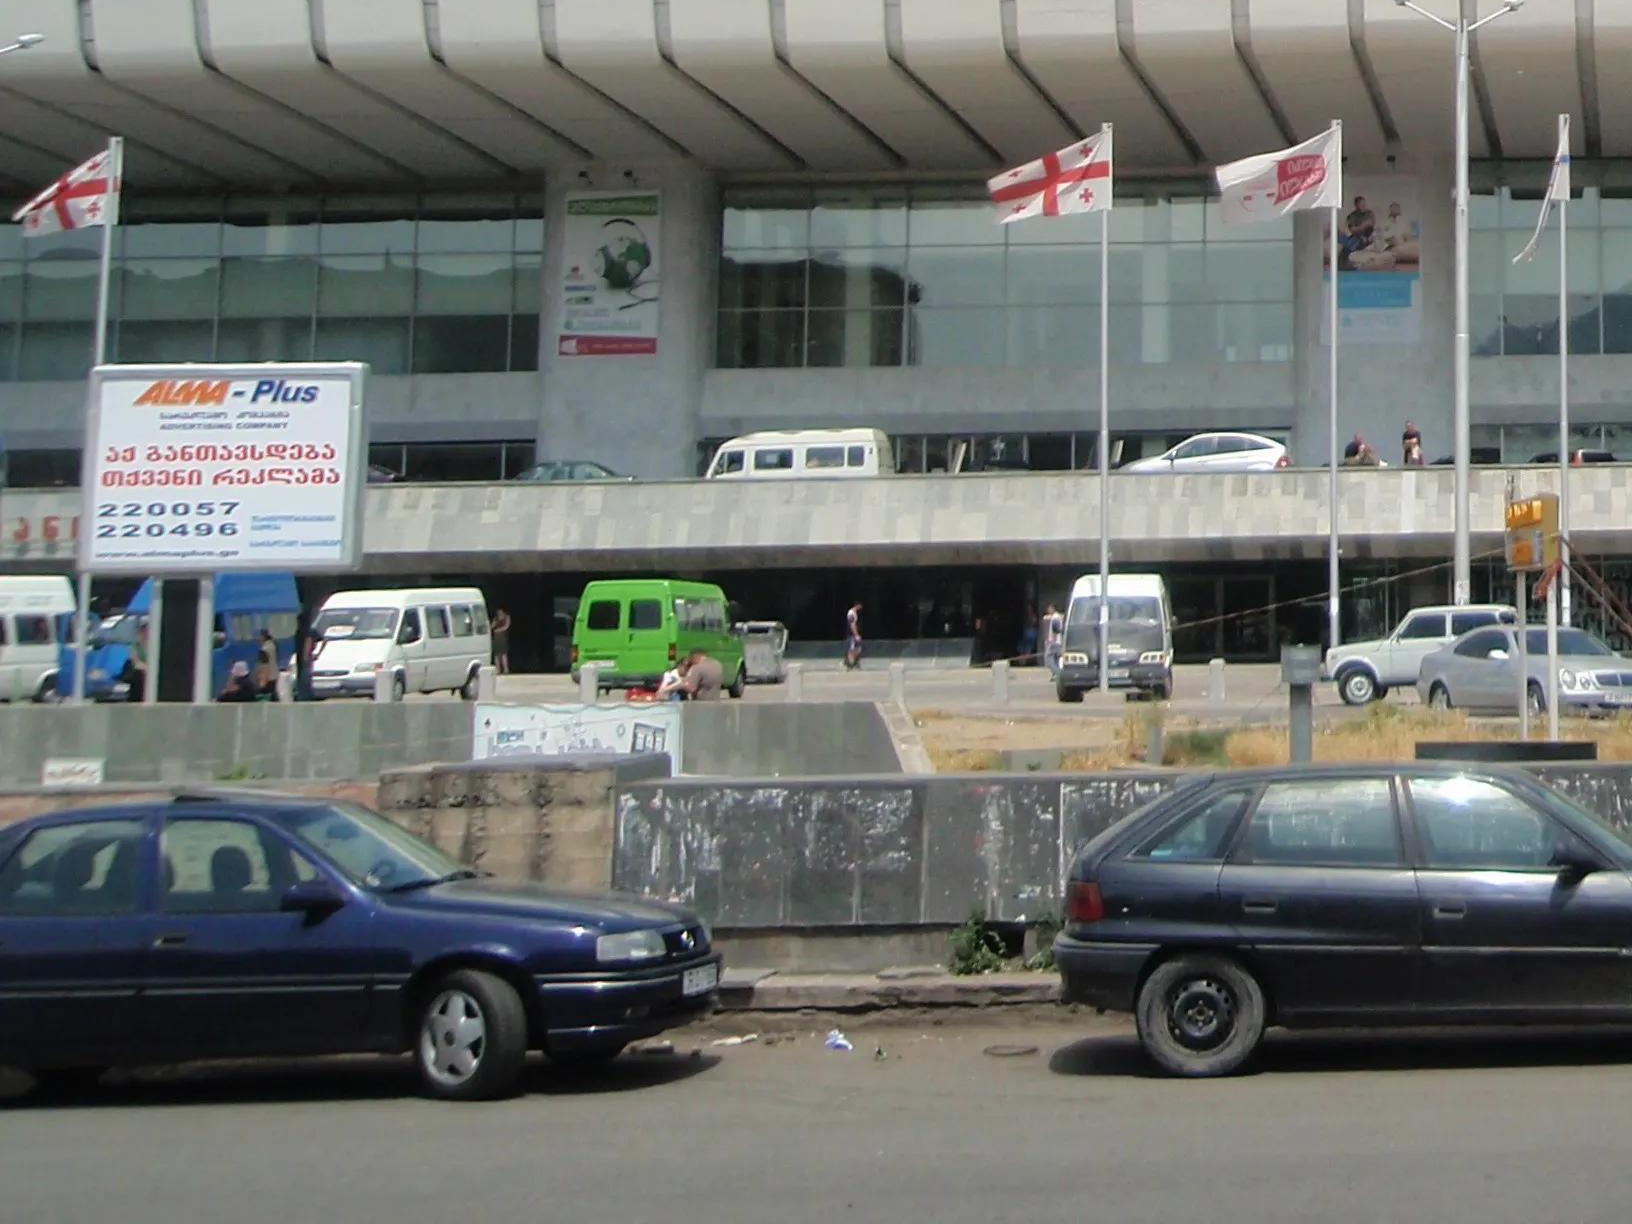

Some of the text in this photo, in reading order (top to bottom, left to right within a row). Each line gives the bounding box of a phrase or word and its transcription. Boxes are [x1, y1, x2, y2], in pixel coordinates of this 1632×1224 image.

[133, 379, 231, 406] ALMA
[250, 379, 319, 404] Plus
[235, 421, 289, 430] COMPANY
[104, 443, 337, 464] აქ განთავსდება
[101, 467, 341, 488] თქვენი რეკლამა
[97, 501, 241, 519] 220057
[96, 521, 239, 539] 220496
